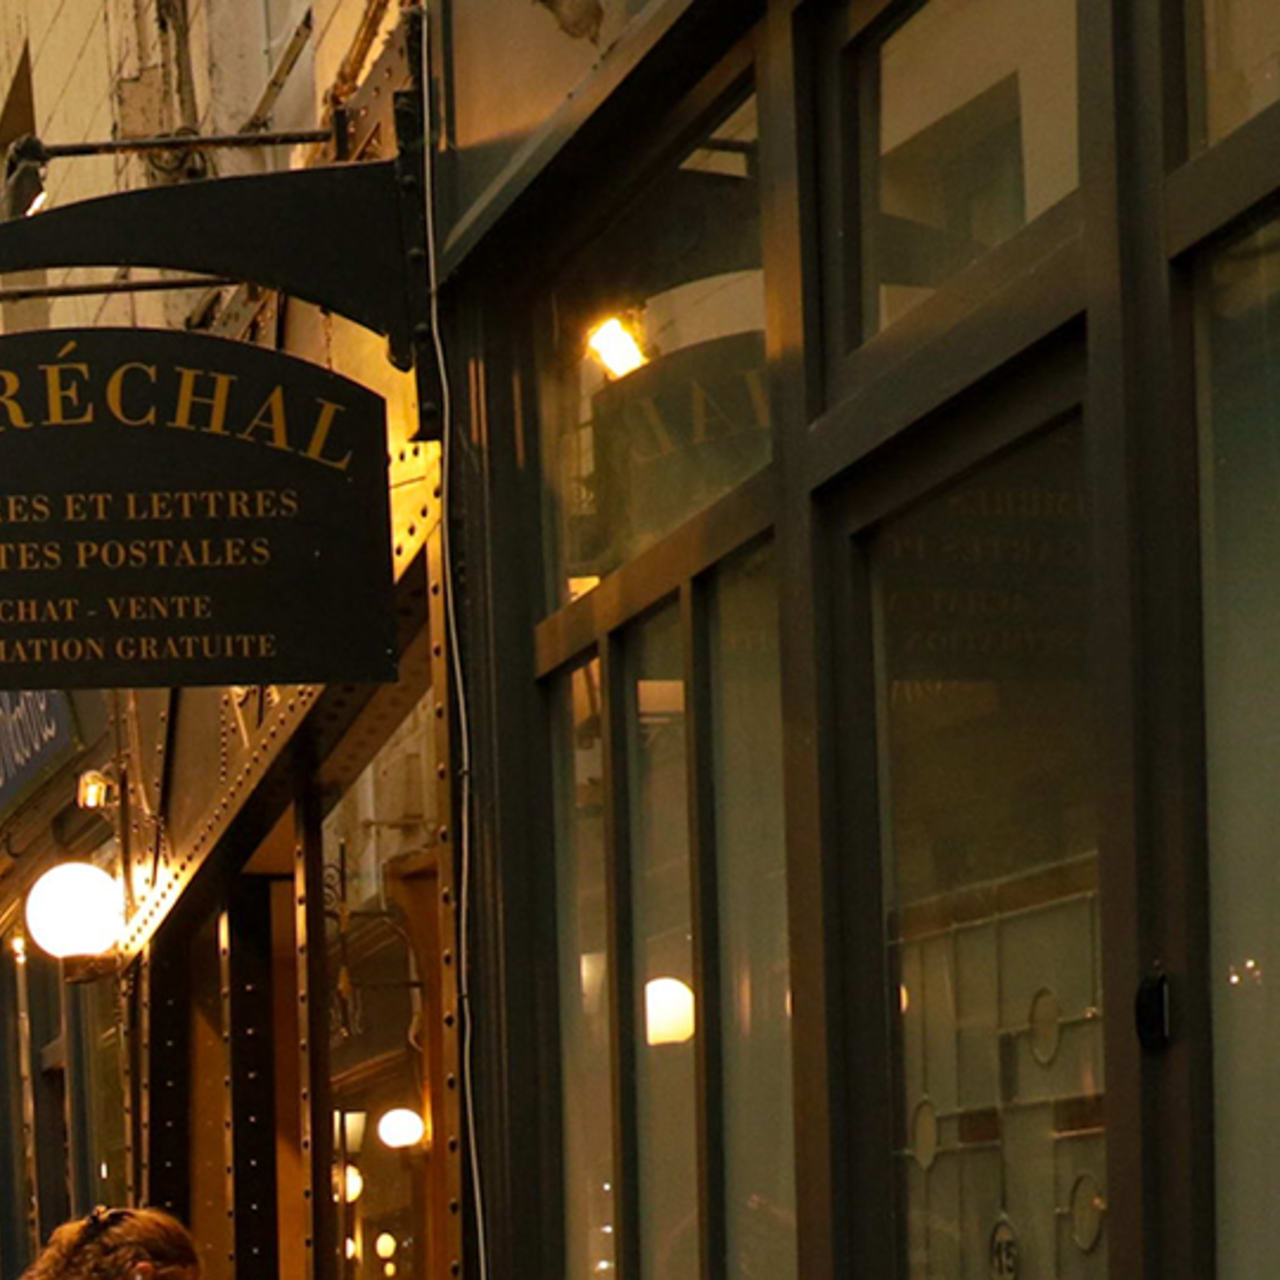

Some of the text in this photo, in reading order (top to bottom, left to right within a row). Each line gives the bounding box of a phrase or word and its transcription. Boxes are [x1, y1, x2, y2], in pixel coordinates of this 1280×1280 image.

[65, 493, 112, 521] ET
[126, 490, 298, 520] LETTRES
[77, 538, 272, 569] POSTALES
[107, 596, 212, 621] VENTE
[116, 635, 276, 660] GRATUITE
